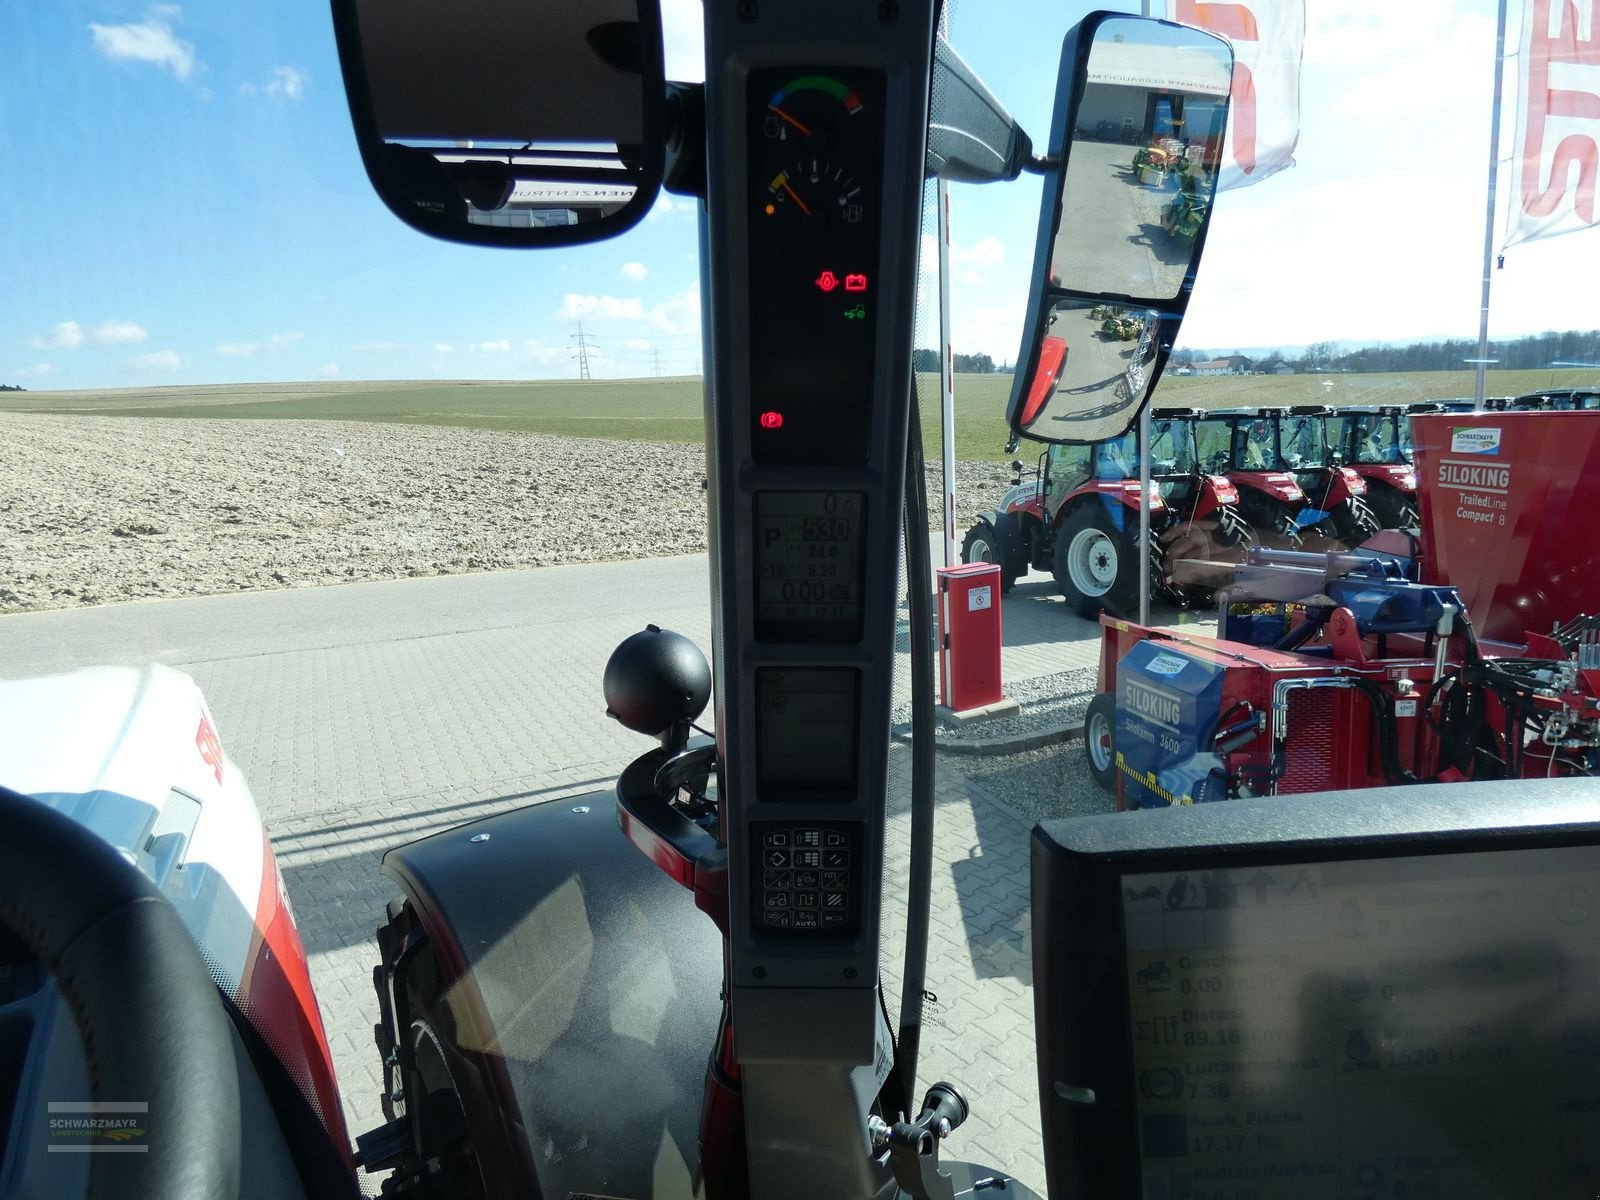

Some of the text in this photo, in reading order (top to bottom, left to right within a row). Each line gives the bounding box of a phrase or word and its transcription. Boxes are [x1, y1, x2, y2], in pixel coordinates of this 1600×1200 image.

[1438, 465, 1510, 488] SILOKING
[1459, 493, 1507, 511] TrailedLine
[1456, 507, 1505, 526] Compact 8
[766, 527, 781, 548] P
[1126, 684, 1180, 725] SILOKING
[1160, 734, 1180, 755] 3600
[1191, 1135, 1246, 1153] 17.17
